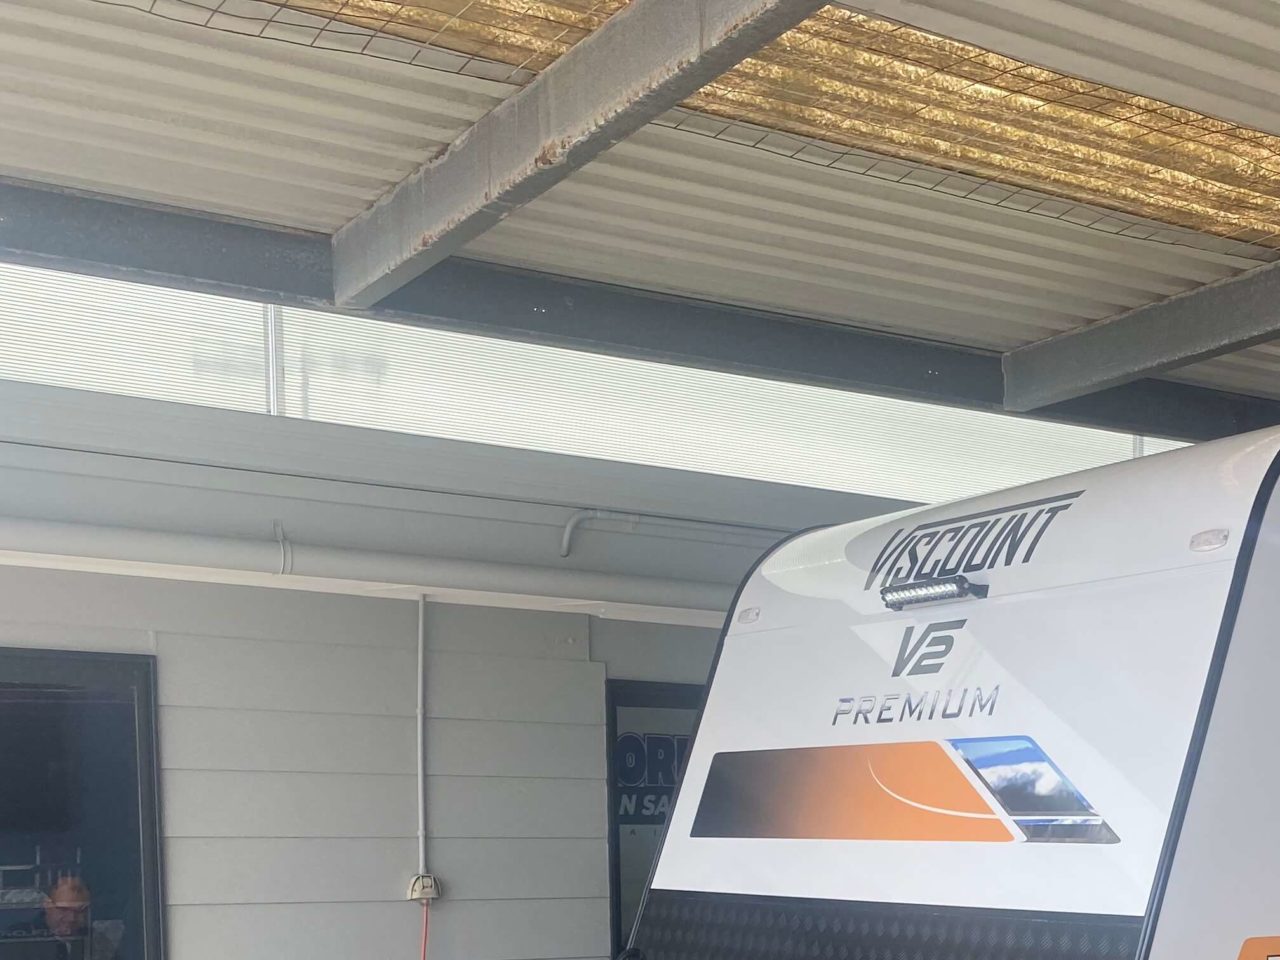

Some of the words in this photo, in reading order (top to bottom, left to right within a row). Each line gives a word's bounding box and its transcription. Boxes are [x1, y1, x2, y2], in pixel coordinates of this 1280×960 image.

[864, 489, 1087, 591] VISCOUNT
[891, 618, 968, 678] V2
[831, 684, 1000, 726] PREMIUM
